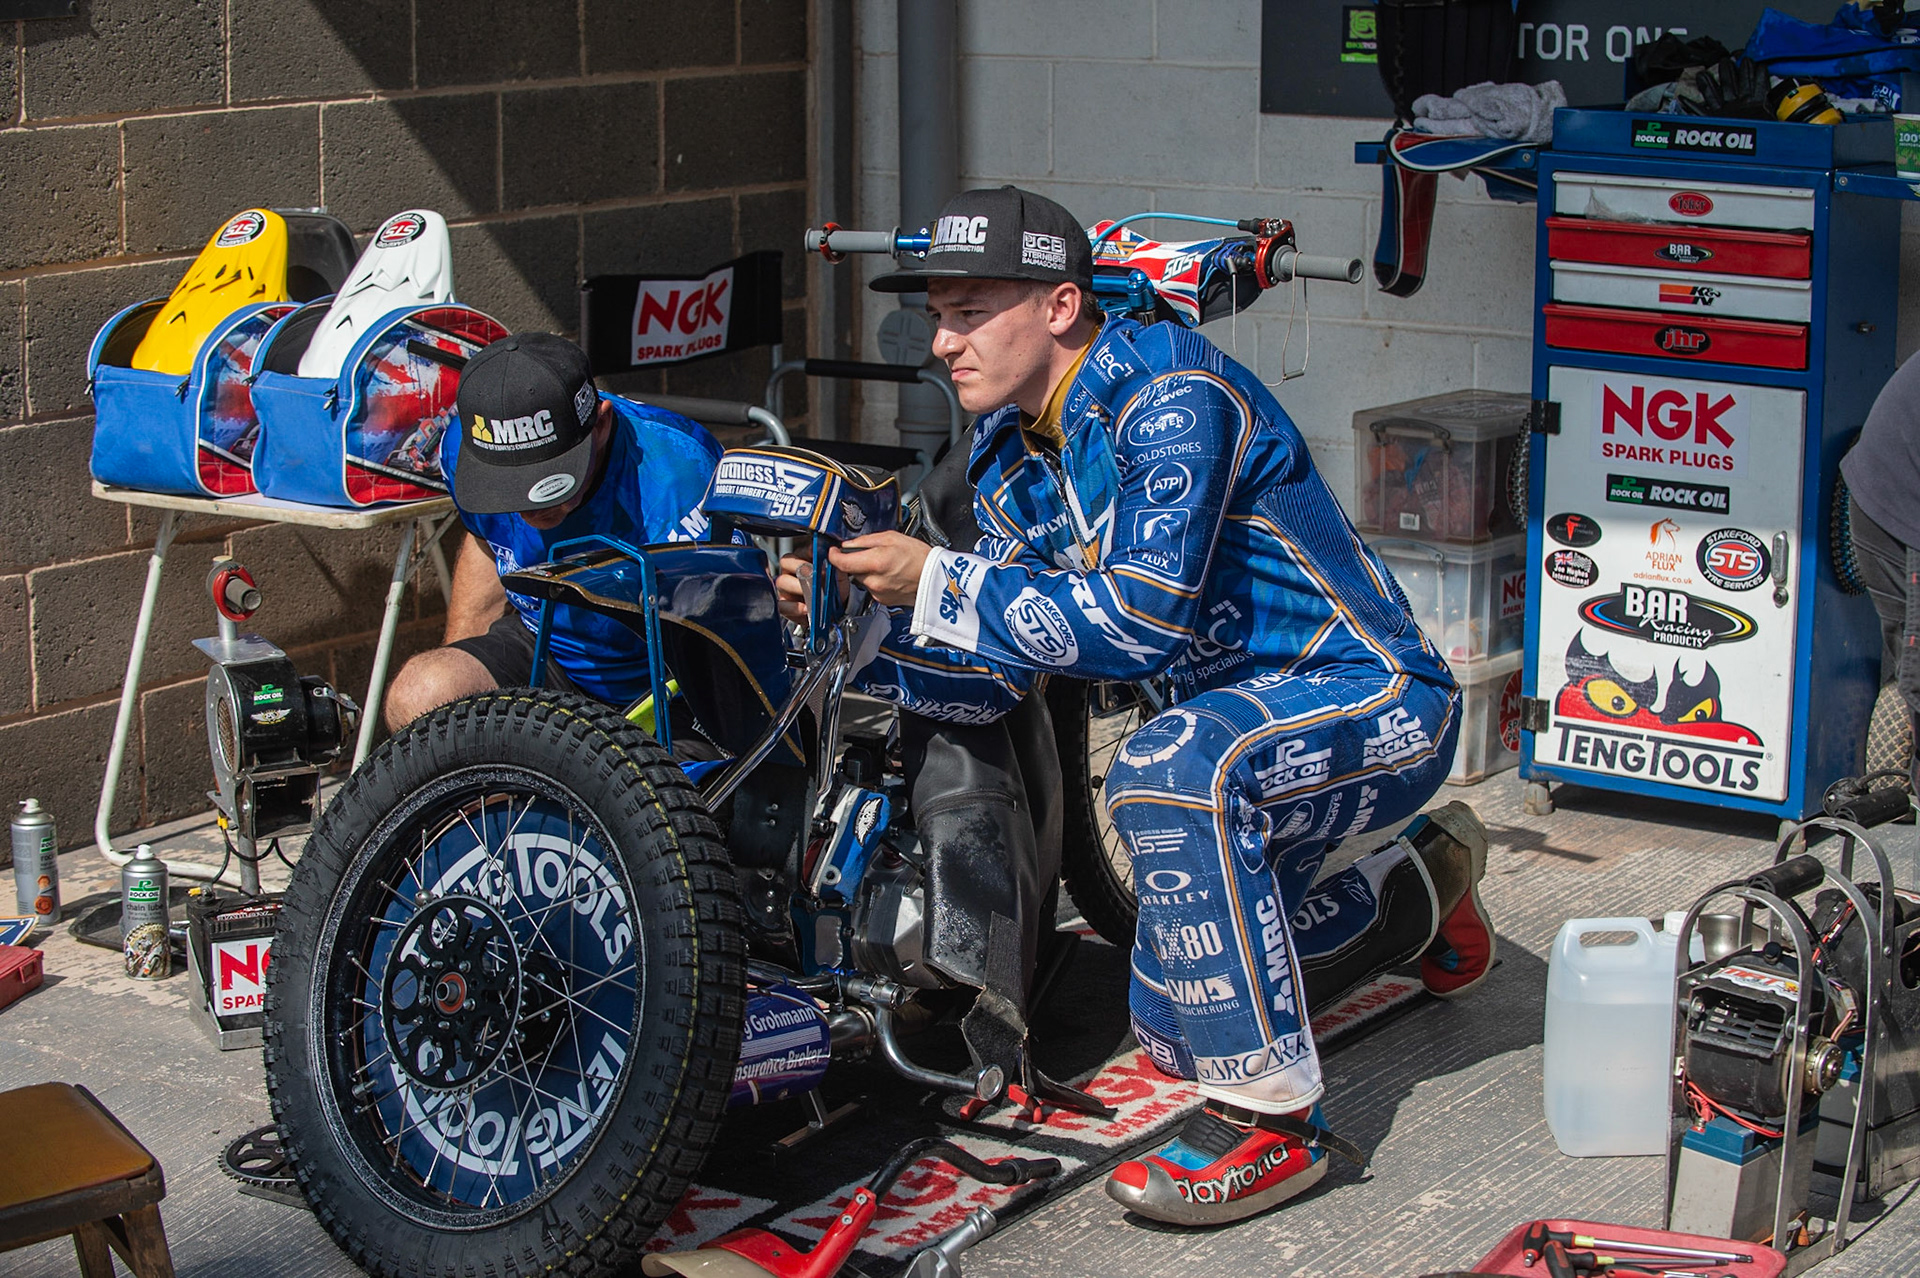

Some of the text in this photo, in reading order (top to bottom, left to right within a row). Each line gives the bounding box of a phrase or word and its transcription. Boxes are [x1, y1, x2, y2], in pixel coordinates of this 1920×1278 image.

[1606, 25, 1688, 63] ON
[1635, 134, 1669, 144] ROCK OIL
[1674, 129, 1754, 149] ROCK OIL
[1899, 132, 1920, 143] 100
[934, 215, 988, 245] MRC
[1025, 234, 1062, 253] JCB
[1669, 243, 1692, 255] BAR
[1022, 250, 1066, 264] STERNBERG
[638, 278, 728, 335] NGK
[1690, 286, 1721, 306] K&N
[1662, 327, 1706, 349] jhr
[637, 344, 683, 360] SPARK
[1152, 385, 1193, 407] covec
[490, 409, 555, 444] MRC
[1139, 415, 1185, 436] FOSTER
[1602, 383, 1736, 449] NGK
[1131, 441, 1202, 466] COLDSTORES
[1602, 442, 1734, 471] SPARK PLUGS
[715, 484, 795, 505] ROBERT LAMBERT RACING
[1152, 475, 1183, 492] ATPI
[1610, 489, 1643, 499] ROCK OIL
[770, 496, 816, 517] 505
[1650, 485, 1727, 509] ROCK OIL
[1706, 529, 1762, 548] STAKEFORD
[1142, 553, 1169, 569] FLUX
[1645, 551, 1683, 563] ADRIAN
[1652, 560, 1676, 572] FLUX
[1708, 547, 1758, 571] STS
[1503, 572, 1526, 604] NG
[1552, 571, 1590, 586] International
[1633, 571, 1693, 585] adrianflux.co.uk
[1703, 568, 1764, 590] TYRE SERVICES
[1625, 585, 1688, 624] BAR
[1019, 603, 1065, 653] STS
[1032, 595, 1075, 648] STAKEFORD
[1638, 612, 1713, 644] Racing
[1653, 630, 1704, 648] PRODUCTS
[1196, 649, 1255, 680] specialists
[1554, 721, 1764, 791] TENGTOOLS
[1260, 758, 1331, 791] OCK OIL
[127, 903, 164, 912] chain lube
[1141, 890, 1209, 906] OAKLEY
[1256, 894, 1290, 984] MRC
[749, 1006, 817, 1033] Grohmann
[734, 1045, 823, 1081] nsurance Broker
